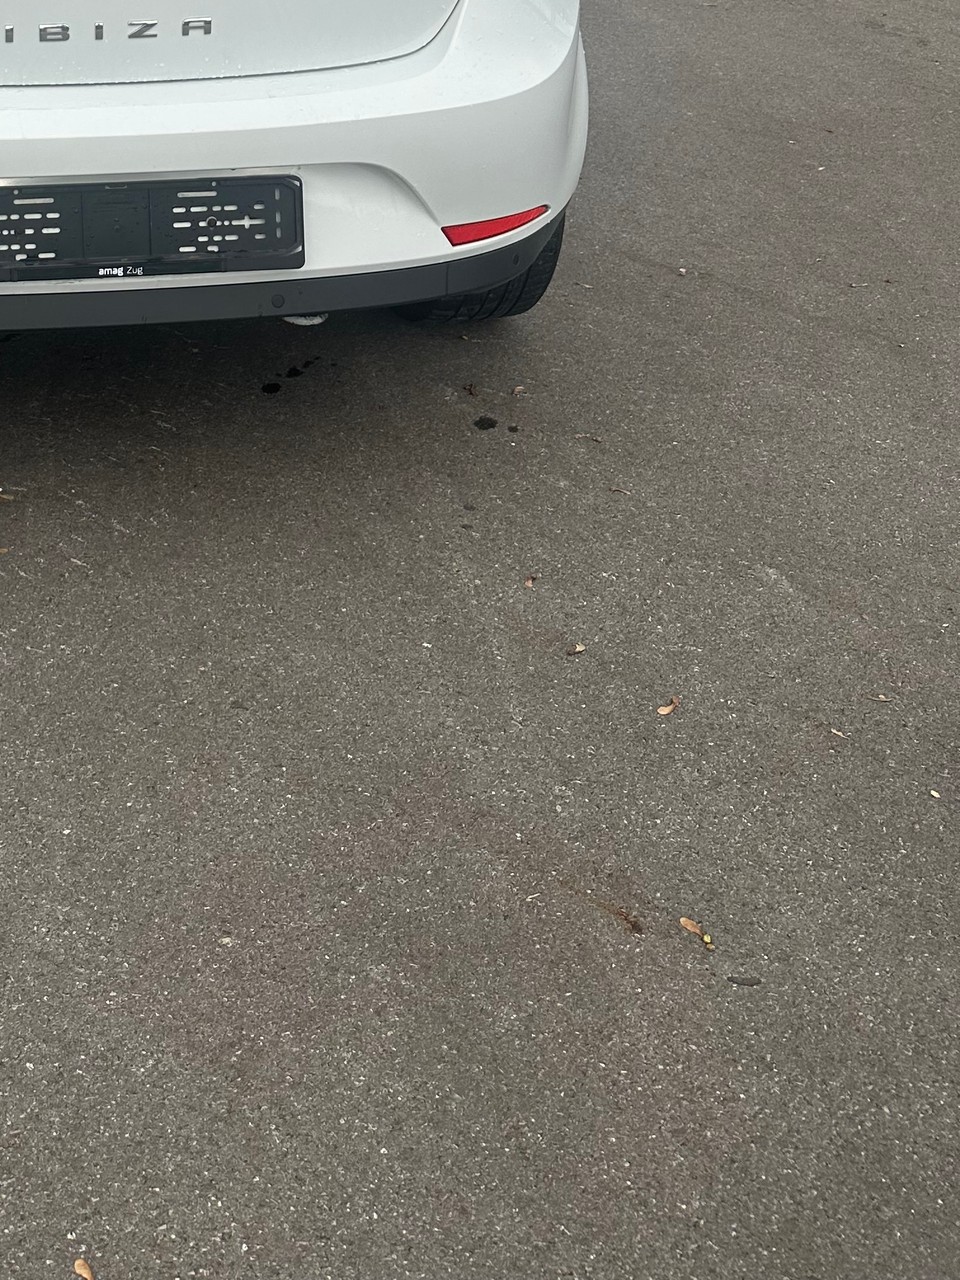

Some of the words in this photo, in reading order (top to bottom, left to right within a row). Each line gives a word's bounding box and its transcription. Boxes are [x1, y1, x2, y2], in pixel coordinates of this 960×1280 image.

[4, 17, 212, 43] IBIZA
[98, 266, 124, 277] amag
[126, 265, 144, 276] Zug
